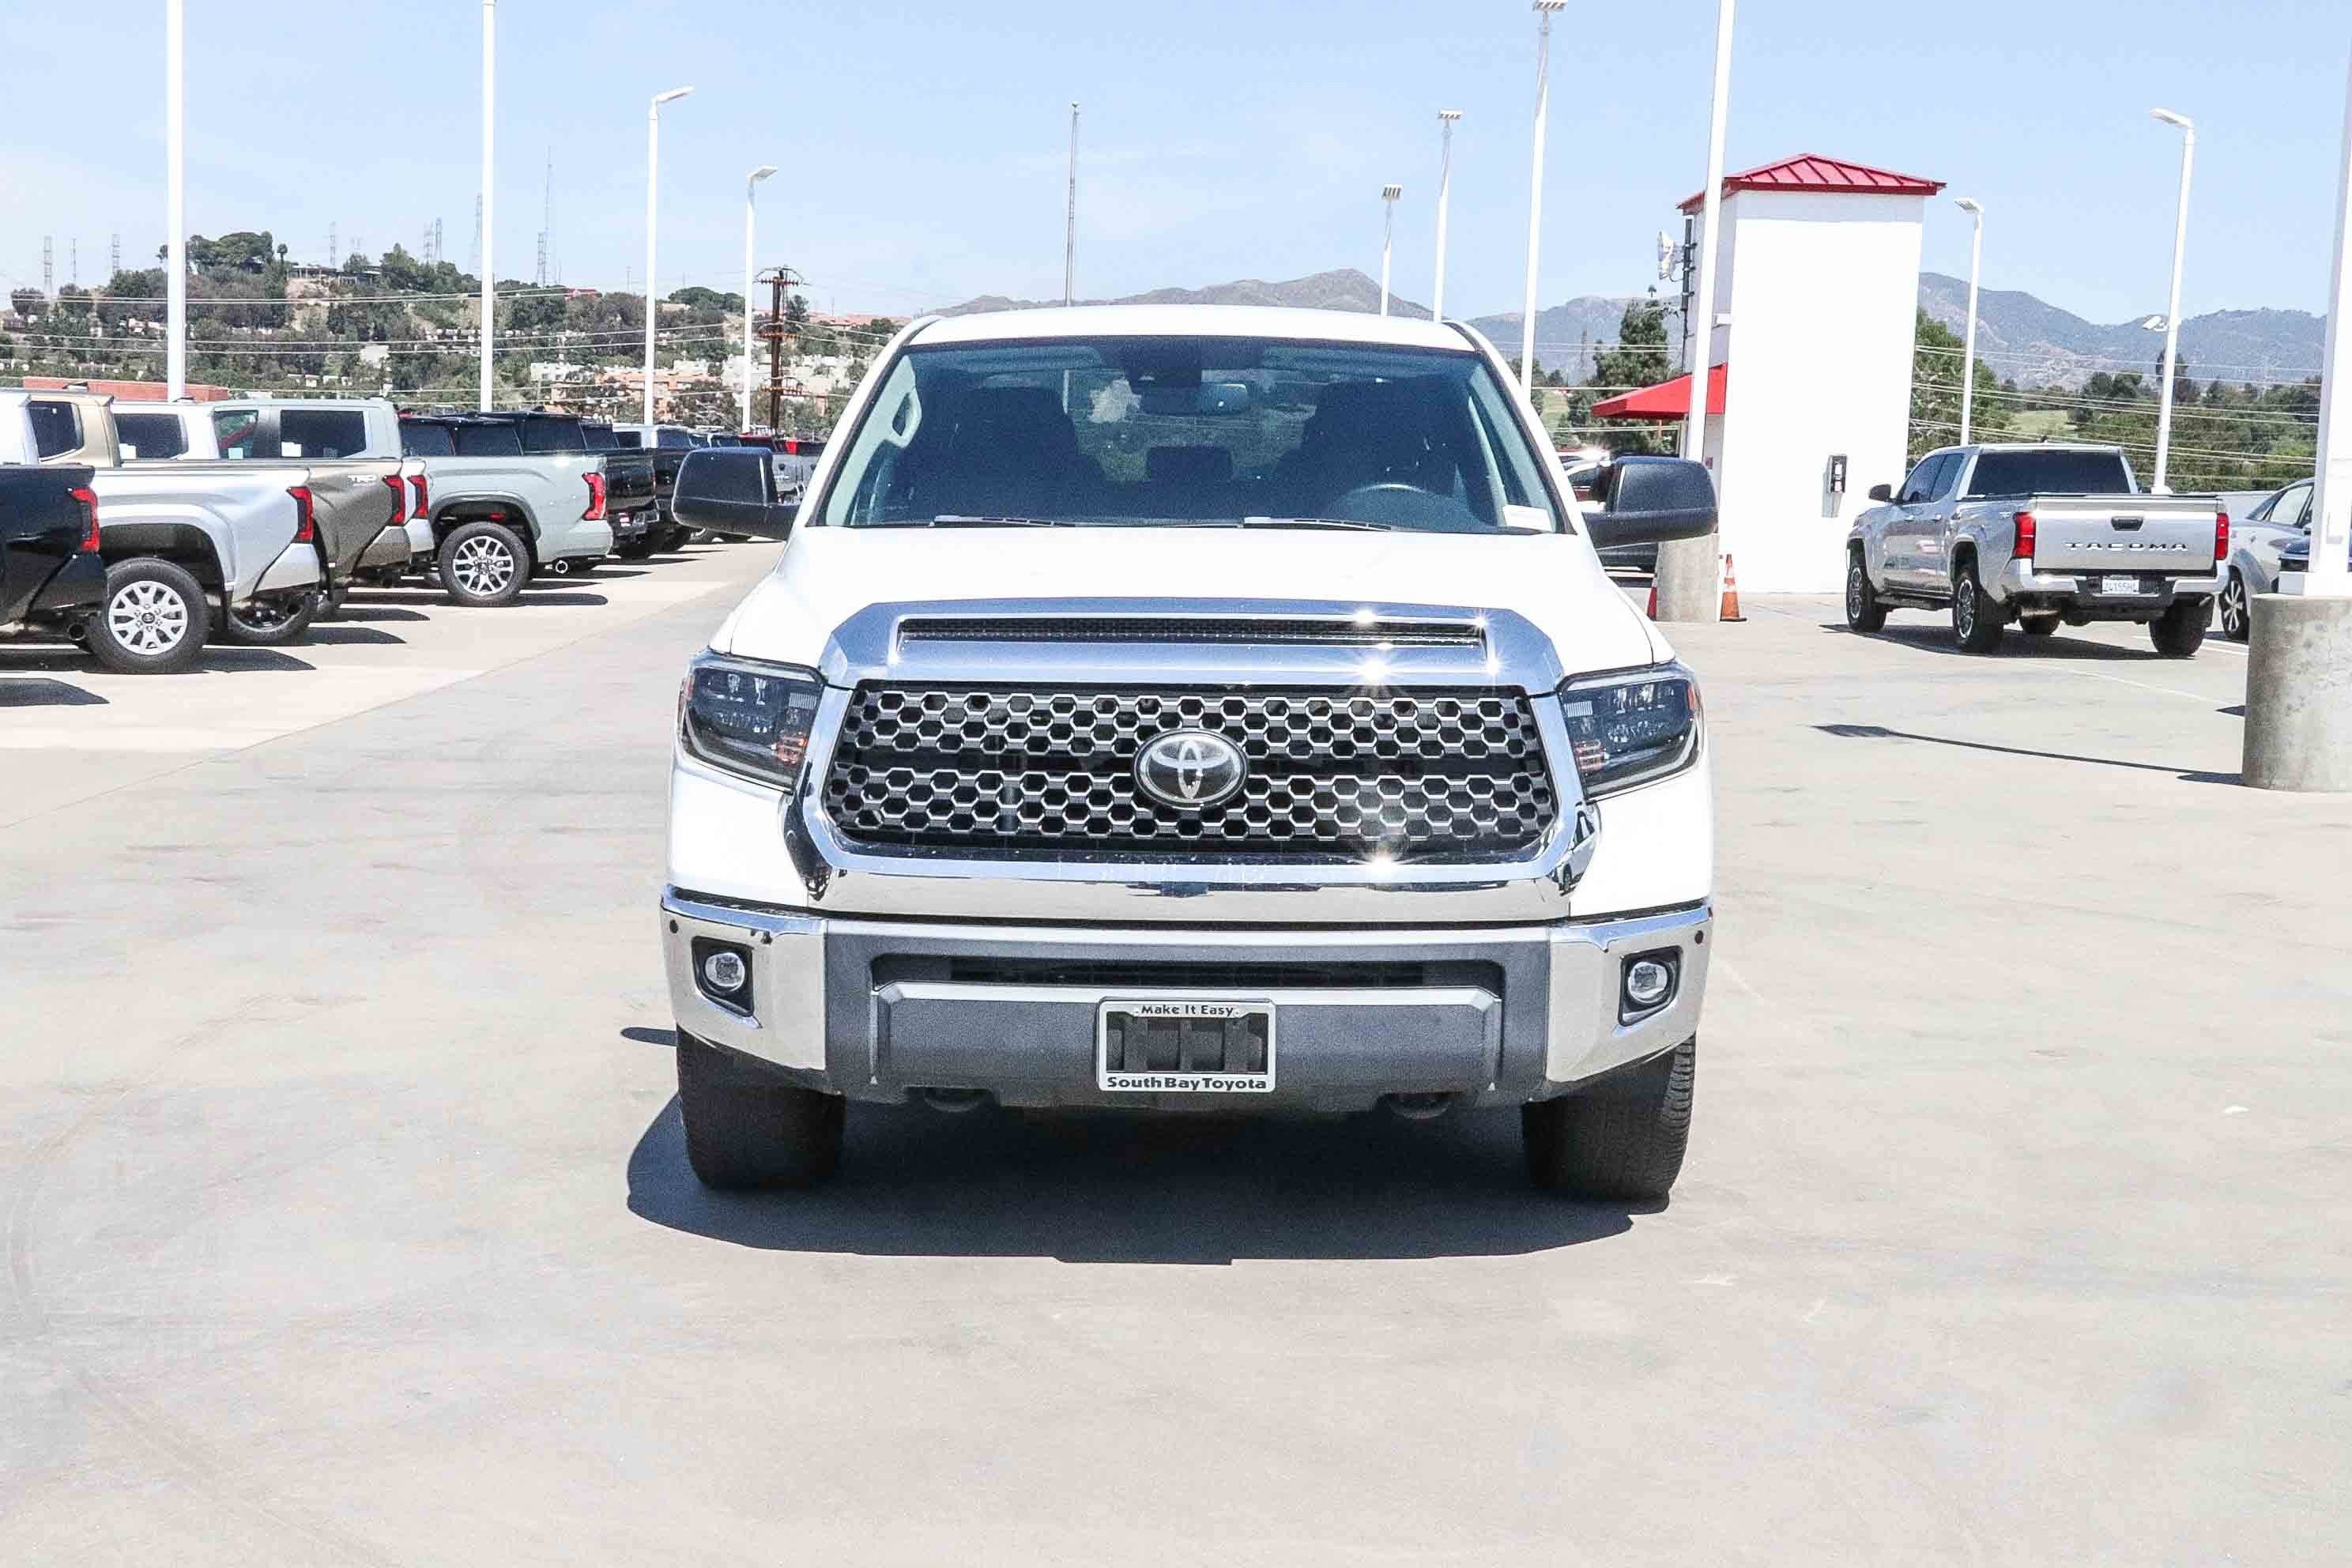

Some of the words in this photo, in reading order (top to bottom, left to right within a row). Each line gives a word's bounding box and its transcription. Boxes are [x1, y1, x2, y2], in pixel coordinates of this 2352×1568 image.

[2065, 541, 2188, 551] TACOMA
[1141, 1004, 1180, 1015] Make
[1185, 1005, 1197, 1015] It
[1107, 1077, 1162, 1087] South
[1201, 1078, 1267, 1091] Toyota
